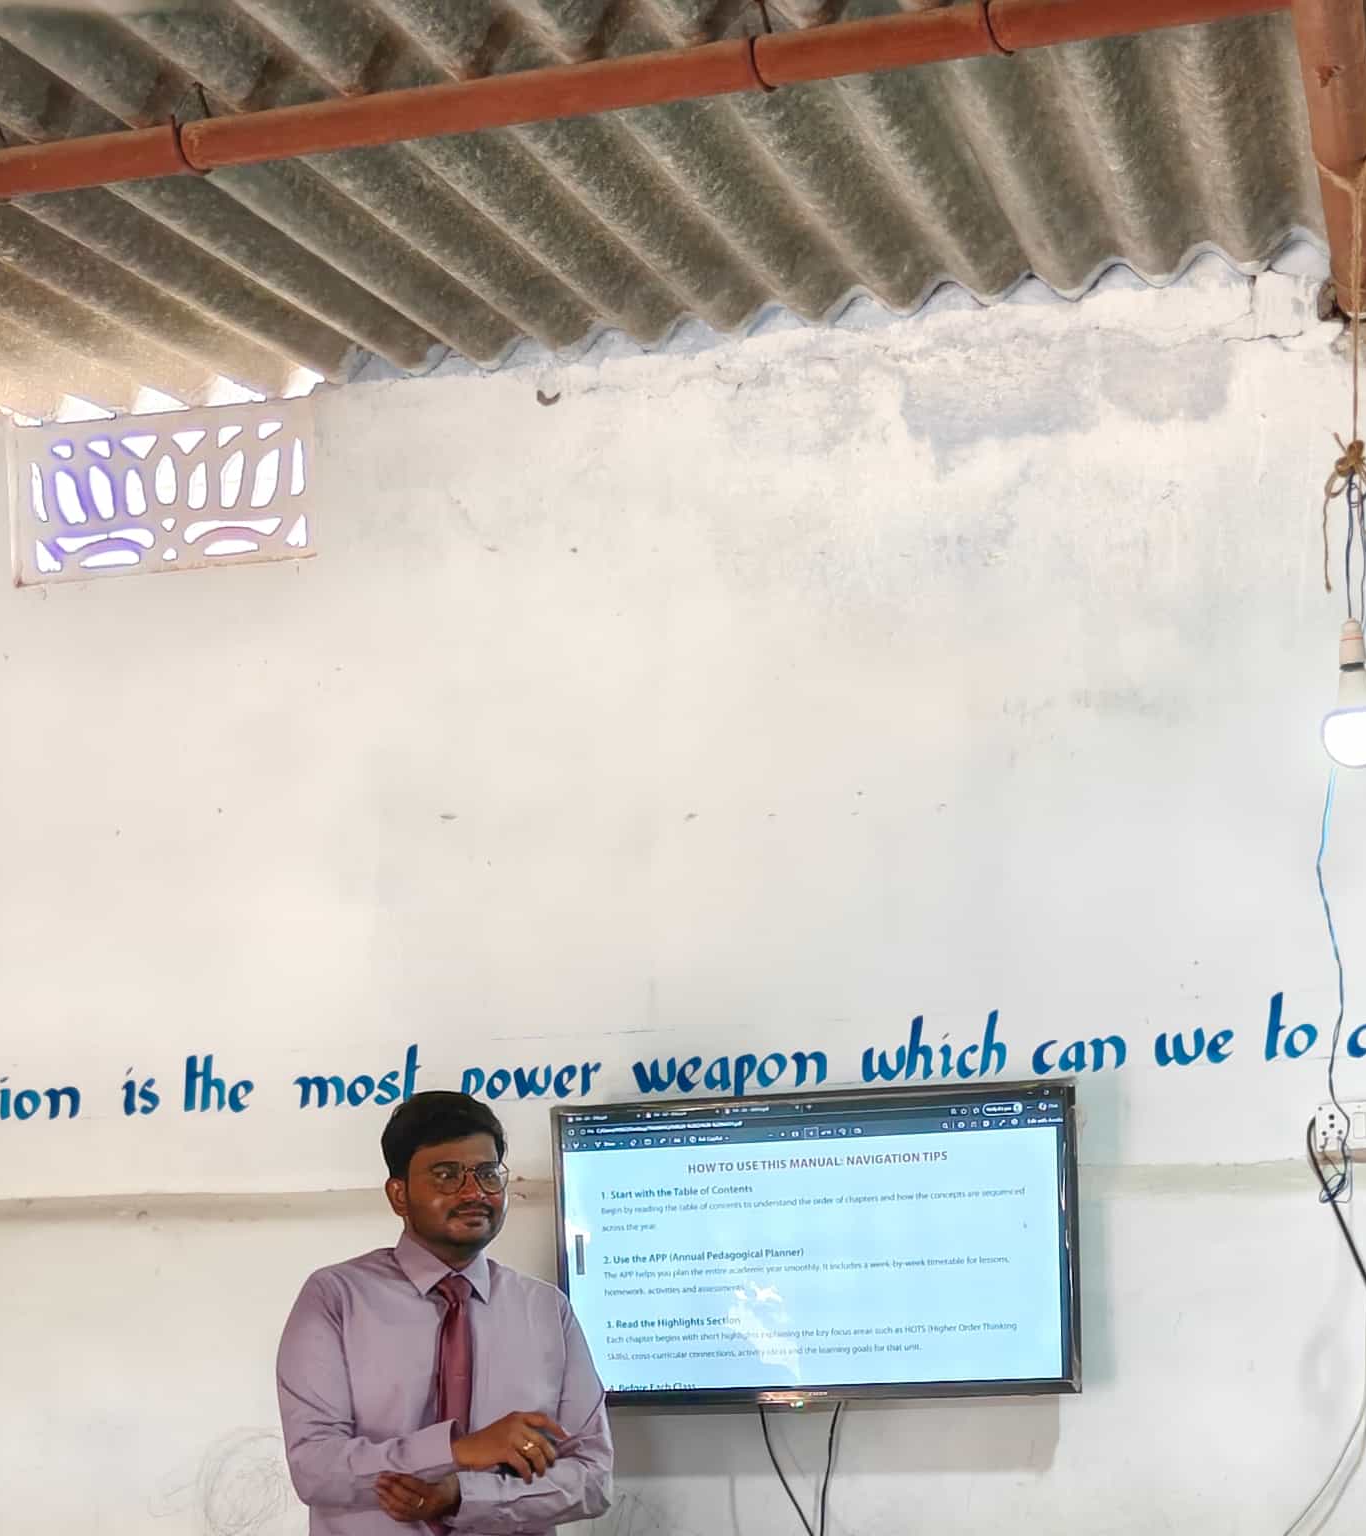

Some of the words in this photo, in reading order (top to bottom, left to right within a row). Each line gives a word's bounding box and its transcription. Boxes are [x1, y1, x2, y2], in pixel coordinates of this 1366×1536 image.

[122, 1067, 161, 1116] is
[184, 1054, 254, 1114] the
[293, 1044, 423, 1109] most
[461, 1061, 602, 1101] power
[631, 1047, 828, 1097] weapon
[862, 1009, 1007, 1083] which
[1031, 1032, 1127, 1074] can
[1154, 1025, 1234, 1066] we
[1264, 991, 1318, 1062] to
[688, 1163, 718, 1173] HOW
[719, 1162, 733, 1172] TO
[736, 1160, 761, 1171] USE
[762, 1159, 786, 1169] THIS
[790, 1156, 843, 1168] MANUAL:
[846, 1152, 920, 1165] NAVIGATION
[923, 1151, 948, 1161] TIPS
[610, 1189, 632, 1199] Start
[634, 1188, 654, 1198] with
[657, 1187, 672, 1197] the
[674, 1186, 698, 1196] Table
[700, 1185, 709, 1195] of
[712, 1183, 752, 1194] Contents
[601, 1205, 623, 1216] Begin
[624, 1204, 633, 1215] by
[634, 1203, 663, 1214] reading
[665, 1202, 676, 1211] the
[679, 1202, 698, 1210] table
[709, 1200, 742, 1209] contents
[753, 1197, 796, 1207] understand
[796, 1197, 810, 1205] the
[813, 1196, 834, 1204] order
[845, 1194, 878, 1205] chapters
[880, 1193, 895, 1201] and
[897, 1192, 914, 1200] how
[916, 1191, 928, 1199] the
[930, 1190, 966, 1201] concepts
[982, 1187, 1025, 1199] sequenced
[603, 1254, 611, 1263] 2.
[613, 1254, 629, 1263] Use
[631, 1253, 646, 1262] the
[649, 1252, 667, 1262] APP
[669, 1251, 704, 1263] (Annual
[707, 1249, 762, 1262] Pedagogical
[765, 1248, 804, 1260] Planner)
[604, 1270, 617, 1278] The
[619, 1270, 634, 1278] APP
[635, 1269, 655, 1280] helps
[657, 1270, 671, 1279] you
[673, 1267, 688, 1278] plan
[690, 1267, 702, 1275] the
[704, 1266, 726, 1274] entire
[729, 1264, 762, 1273] academic
[765, 1266, 782, 1274] year
[829, 1260, 861, 1270] includes
[926, 1256, 964, 1266] timetable
[966, 1256, 976, 1264] for
[647, 1285, 680, 1294] activities
[682, 1285, 696, 1293] and
[616, 1318, 638, 1327] Read
[640, 1318, 655, 1327] the
[657, 1316, 704, 1328] Highlights
[706, 1315, 740, 1325] Section
[606, 1335, 624, 1343] Each
[626, 1334, 653, 1345] chapter
[655, 1333, 679, 1344] begins
[682, 1332, 698, 1341] with
[700, 1332, 719, 1340] short
[816, 1328, 828, 1339] key
[831, 1327, 851, 1335] focus
[873, 1326, 892, 1334] such
[905, 1324, 925, 1333] HOTS
[928, 1323, 956, 1335] (Higher
[958, 1323, 980, 1331] Order
[982, 1321, 1016, 1333] Thinking
[819, 1344, 850, 1355] learning
[852, 1344, 872, 1354] goals
